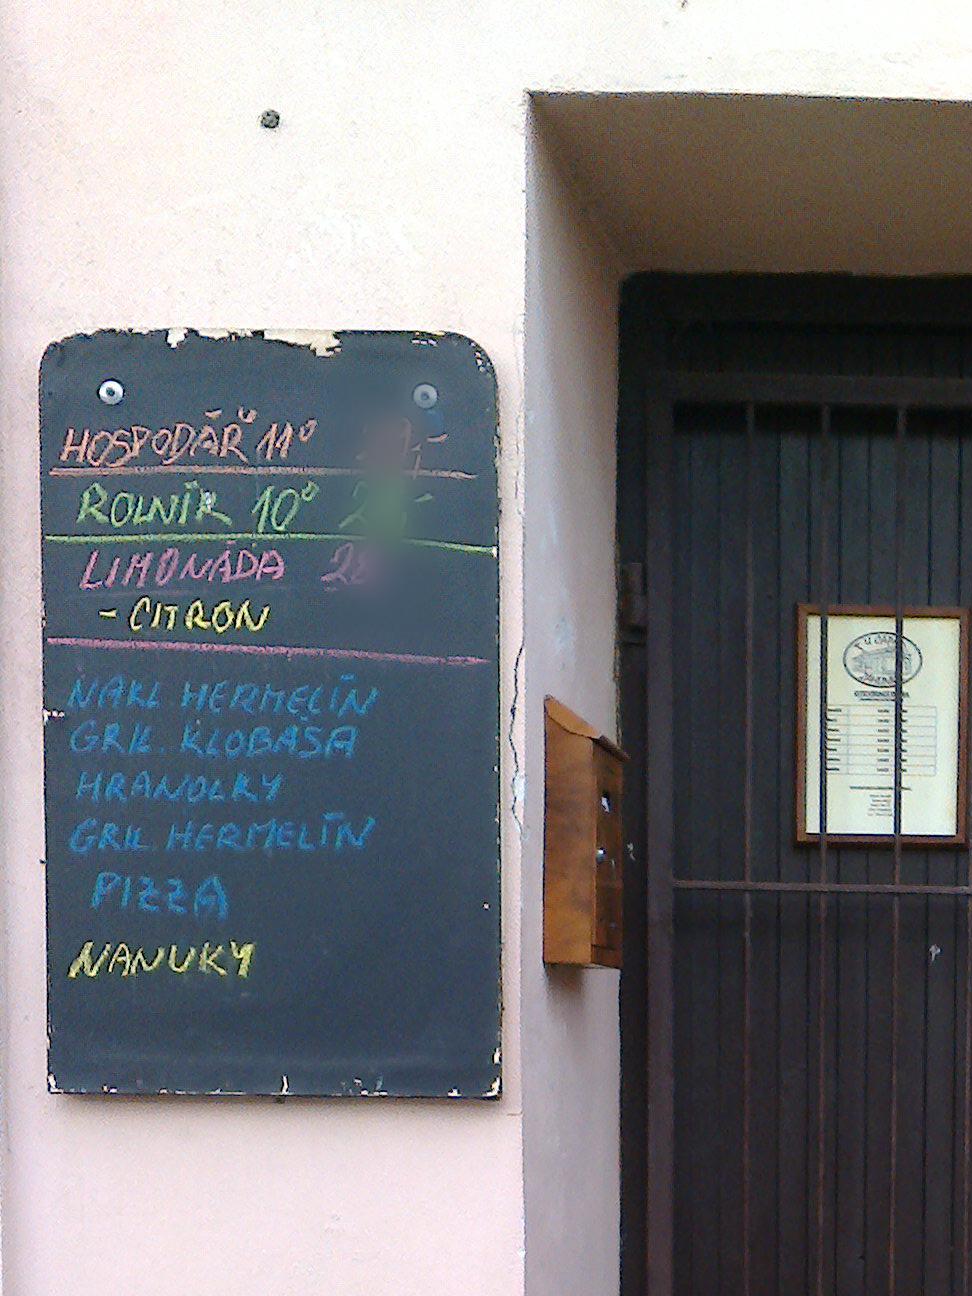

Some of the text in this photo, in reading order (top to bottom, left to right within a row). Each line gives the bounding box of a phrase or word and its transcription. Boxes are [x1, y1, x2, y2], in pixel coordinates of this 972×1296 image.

[79, 540, 285, 590] LIMONÁDA
[76, 770, 284, 803] HRANOLKY
[91, 872, 229, 920] PIZZA
[67, 940, 256, 979] NANUKY
